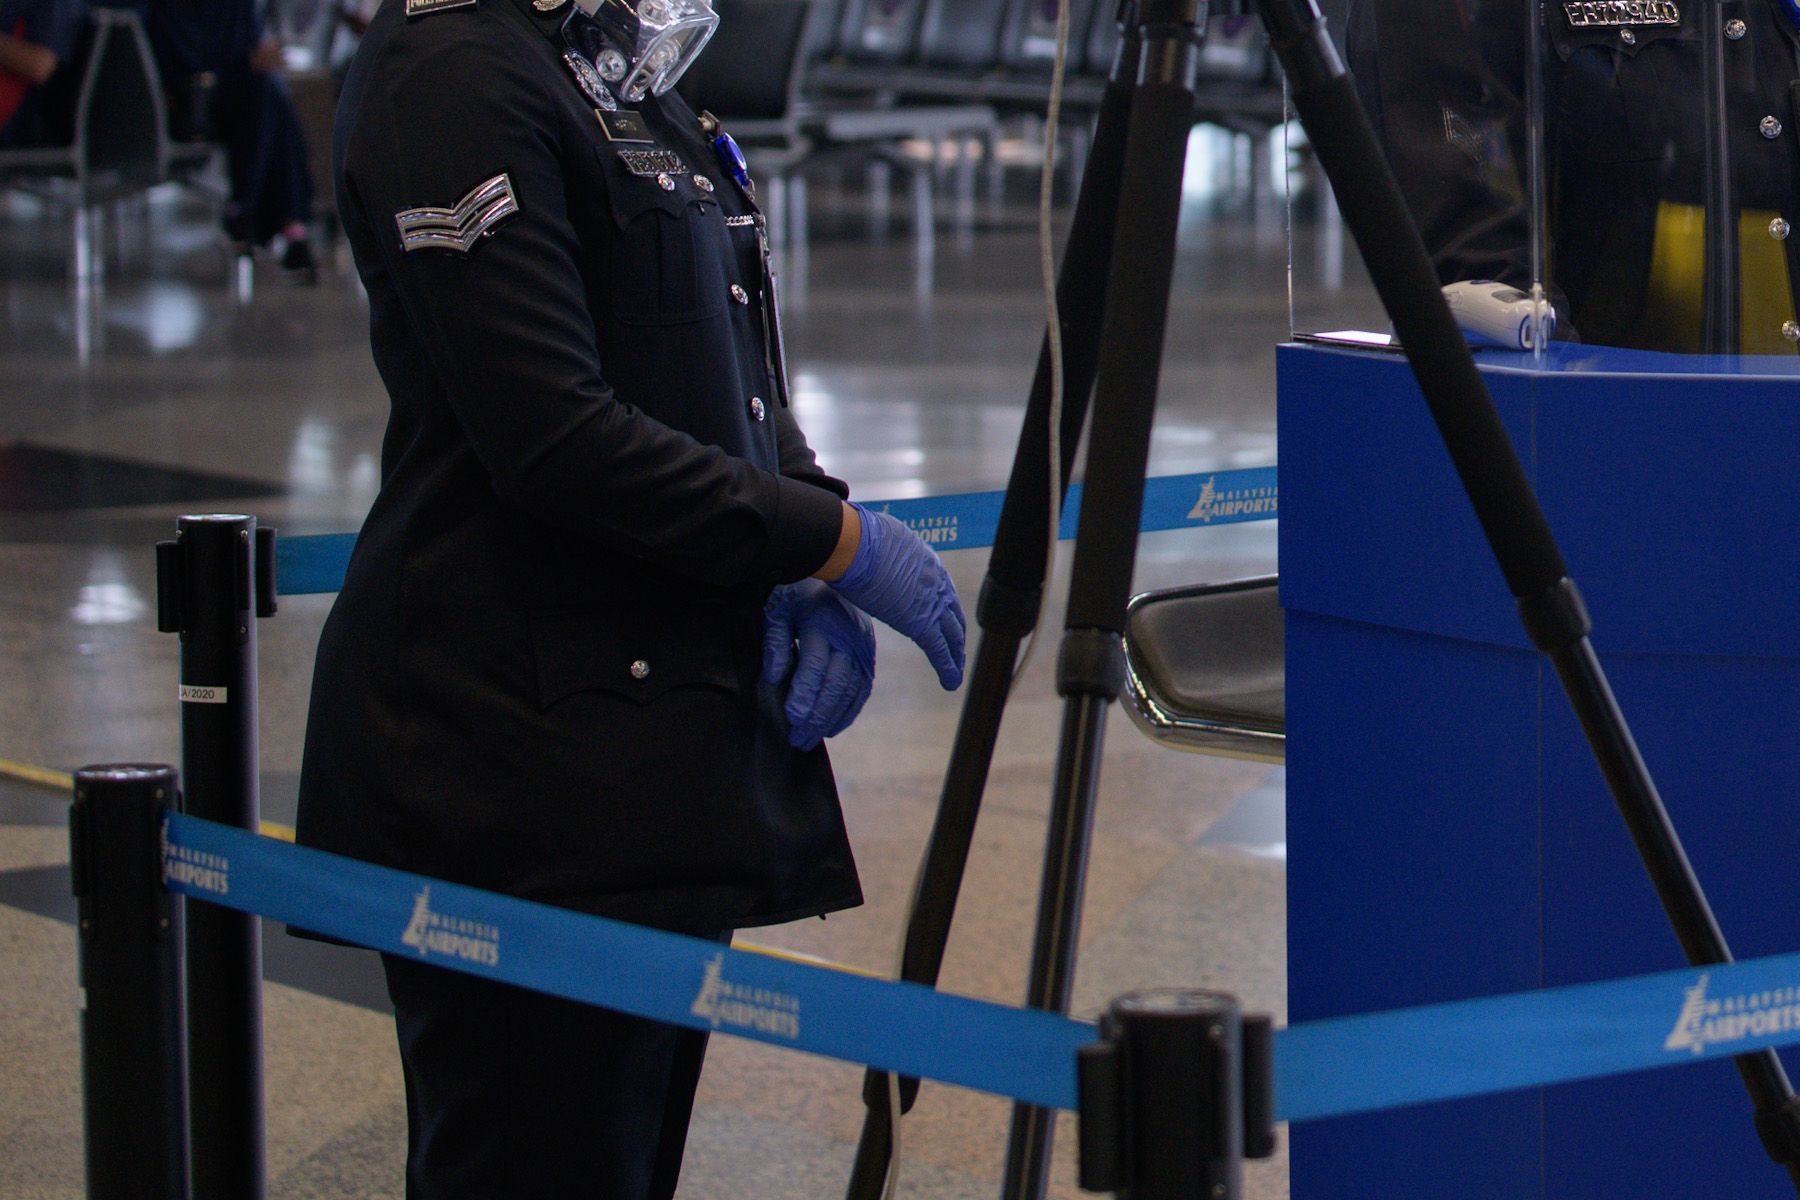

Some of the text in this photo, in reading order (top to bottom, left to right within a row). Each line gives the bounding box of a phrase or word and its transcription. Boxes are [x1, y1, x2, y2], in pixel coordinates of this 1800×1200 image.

[1211, 497, 1278, 517] AIRPORTS
[1215, 486, 1278, 501] MALAYSIA
[426, 929, 499, 967] AIRPORTS
[717, 1000, 800, 1040] AIRPORTS
